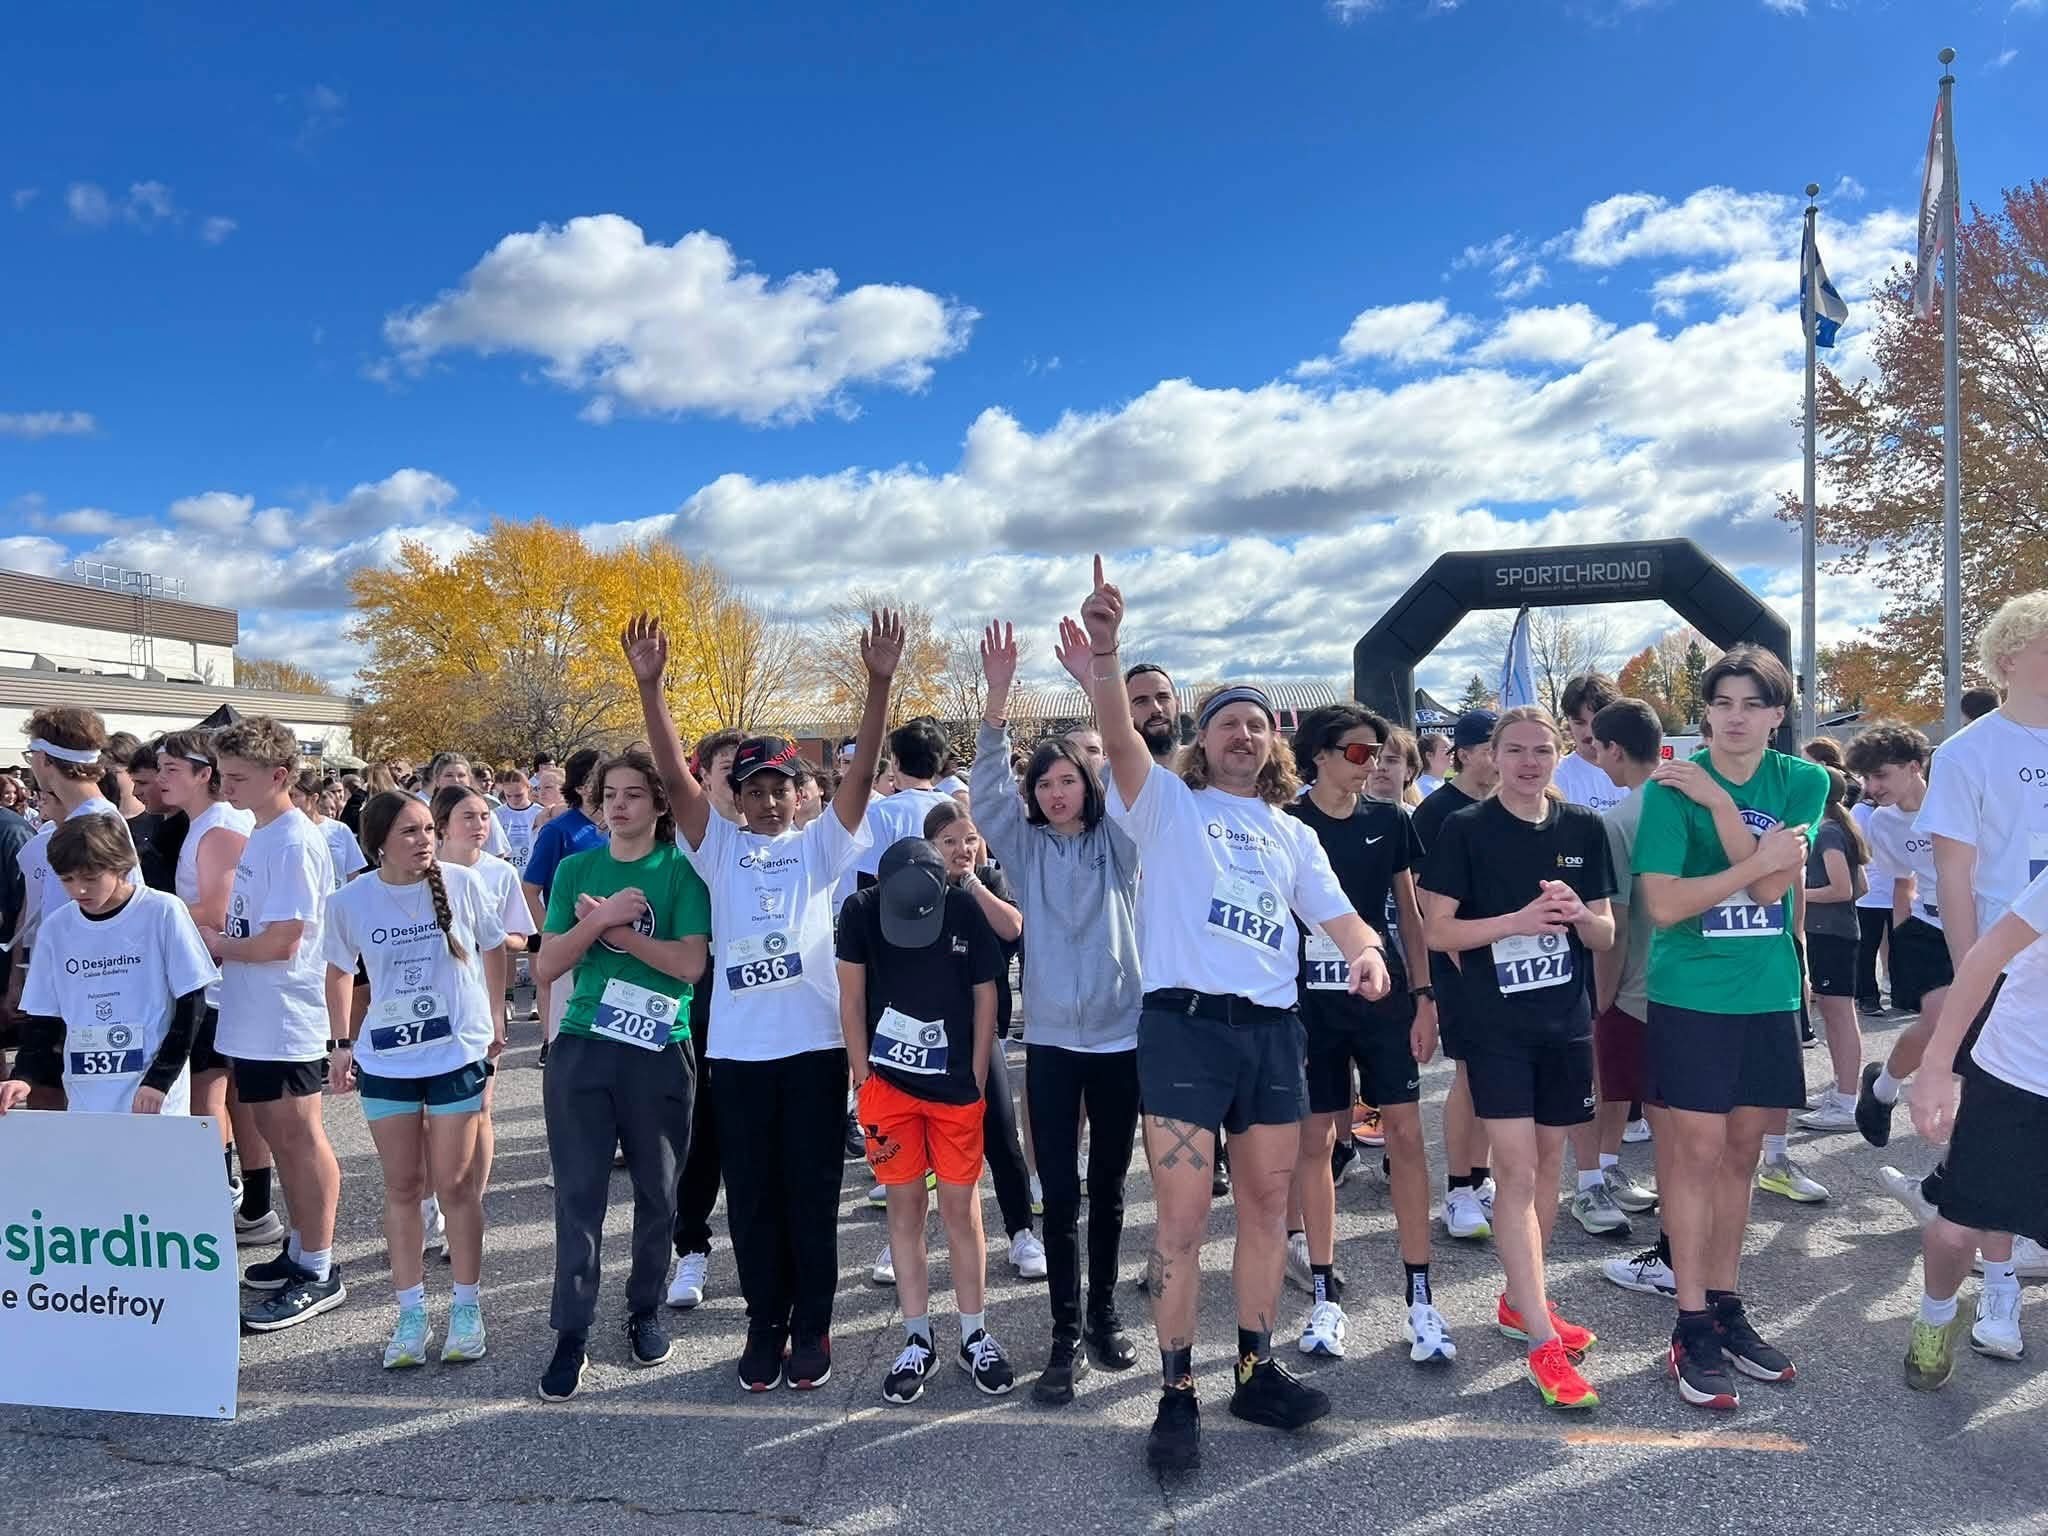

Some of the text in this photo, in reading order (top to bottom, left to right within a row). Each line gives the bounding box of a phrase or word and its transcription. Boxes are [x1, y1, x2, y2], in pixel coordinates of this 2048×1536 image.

[1496, 560, 1651, 587] SPORTCHRONO
[391, 921, 440, 937] Desjardi
[1220, 904, 1278, 945] 1137
[1720, 906, 1769, 929] 114
[82, 955, 141, 970] Desjardins
[741, 957, 789, 987] 636
[1505, 953, 1565, 984] 1127
[394, 1021, 426, 1046] 37
[607, 1009, 657, 1041] 208
[83, 1051, 127, 1074] 537
[887, 1042, 929, 1067] 451
[0, 1208, 220, 1276] sjardins
[27, 1282, 165, 1325] Godefroy
